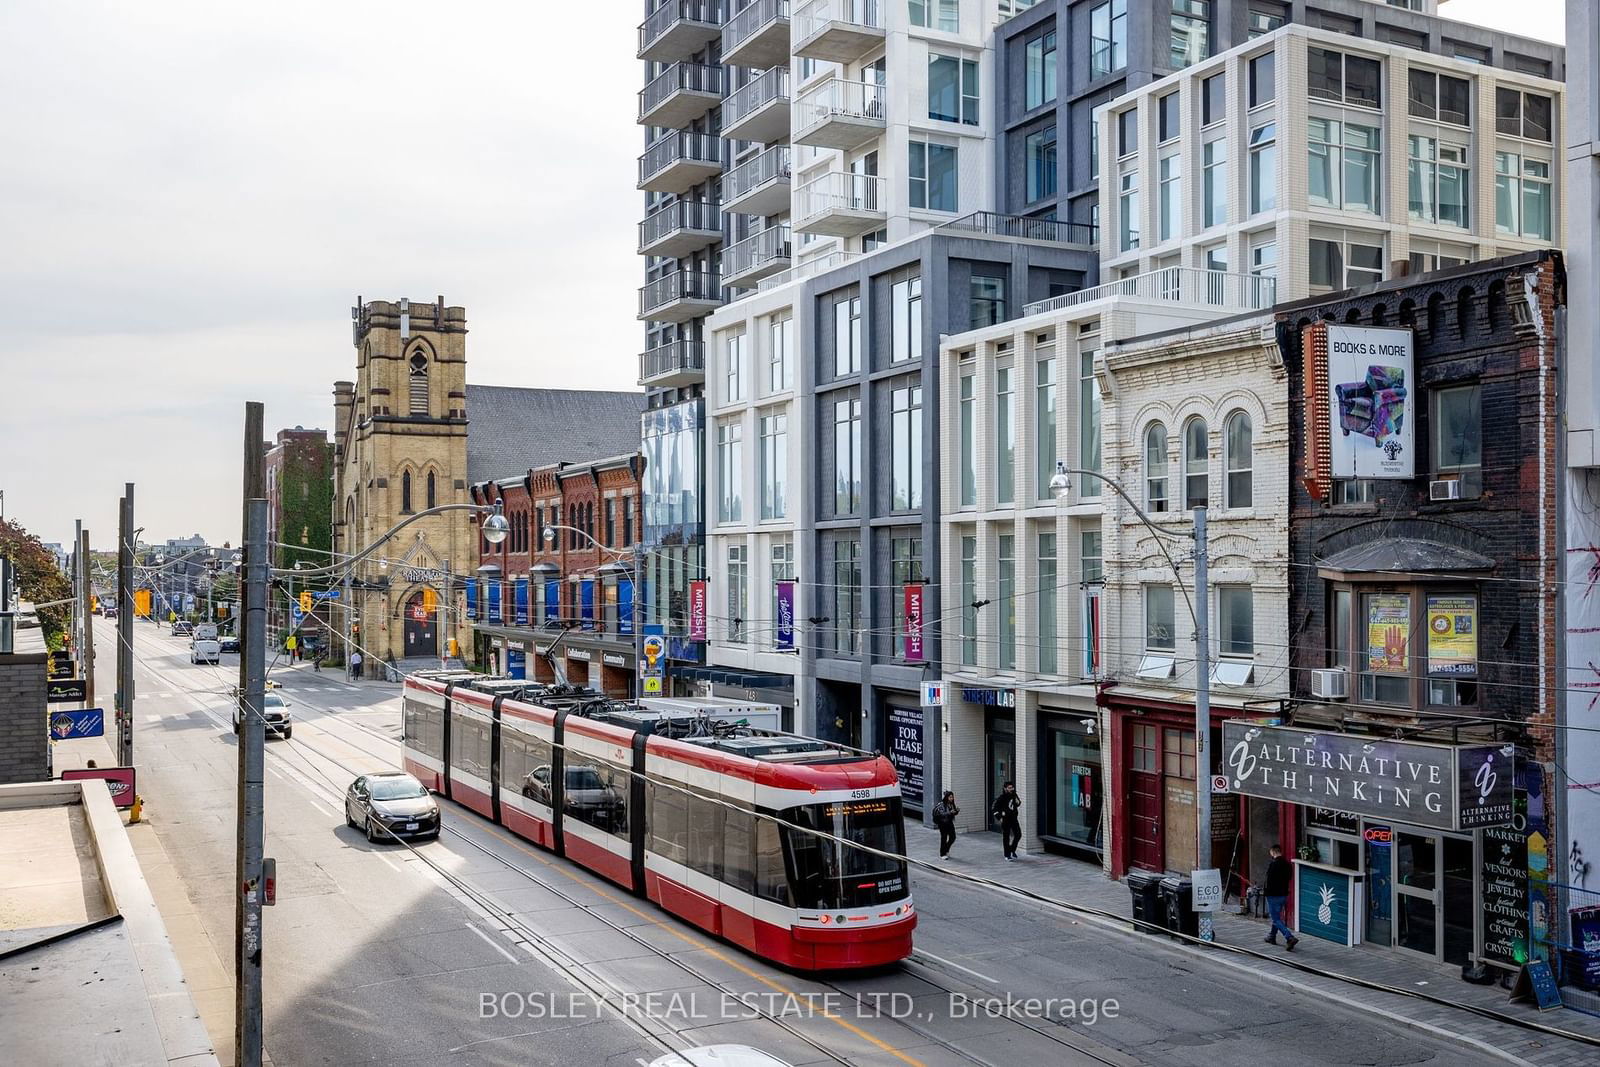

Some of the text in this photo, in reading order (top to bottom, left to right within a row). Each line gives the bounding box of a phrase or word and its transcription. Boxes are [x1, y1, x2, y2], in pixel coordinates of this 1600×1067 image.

[1333, 341, 1406, 356] BOOKS & MORE
[695, 589, 703, 634] MIRVISH
[997, 691, 1015, 708] LAB
[899, 726, 918, 742] FOR
[894, 739, 923, 755] LEASE
[1072, 764, 1091, 776] STRETCH
[1259, 743, 1441, 785] ALTERNATIVE
[851, 790, 870, 799] 4598
[1072, 791, 1091, 808] LAB
[1461, 805, 1510, 817] ALTERNATIVE
[1486, 828, 1526, 844] MARKET
[1485, 863, 1527, 879] VENDORS
[1198, 885, 1219, 896] ECO
[1487, 882, 1525, 899] JEWELRY
[1483, 902, 1530, 920] CLOTHING
[1489, 923, 1524, 939] CRAFTS
